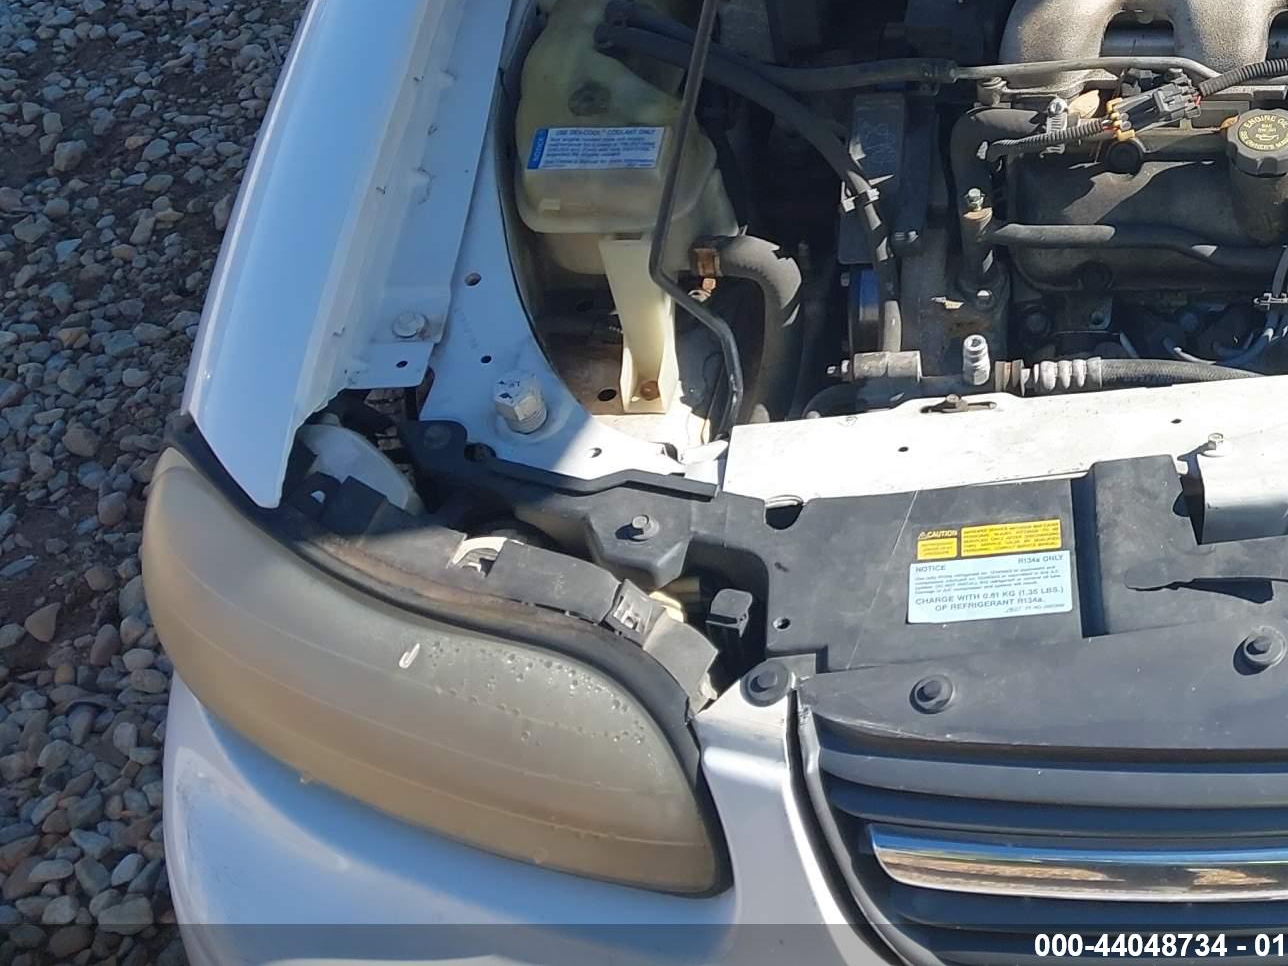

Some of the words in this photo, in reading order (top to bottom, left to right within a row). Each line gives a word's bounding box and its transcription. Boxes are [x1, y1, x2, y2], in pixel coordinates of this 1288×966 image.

[1243, 115, 1277, 129] ENGINE
[927, 530, 958, 539] CAUTION
[1042, 554, 1063, 562] ONLY
[915, 596, 954, 605] CHARGE
[1040, 586, 1064, 594] LBS.)
[934, 604, 948, 612] OF
[950, 599, 1014, 611] REFRIGERANT
